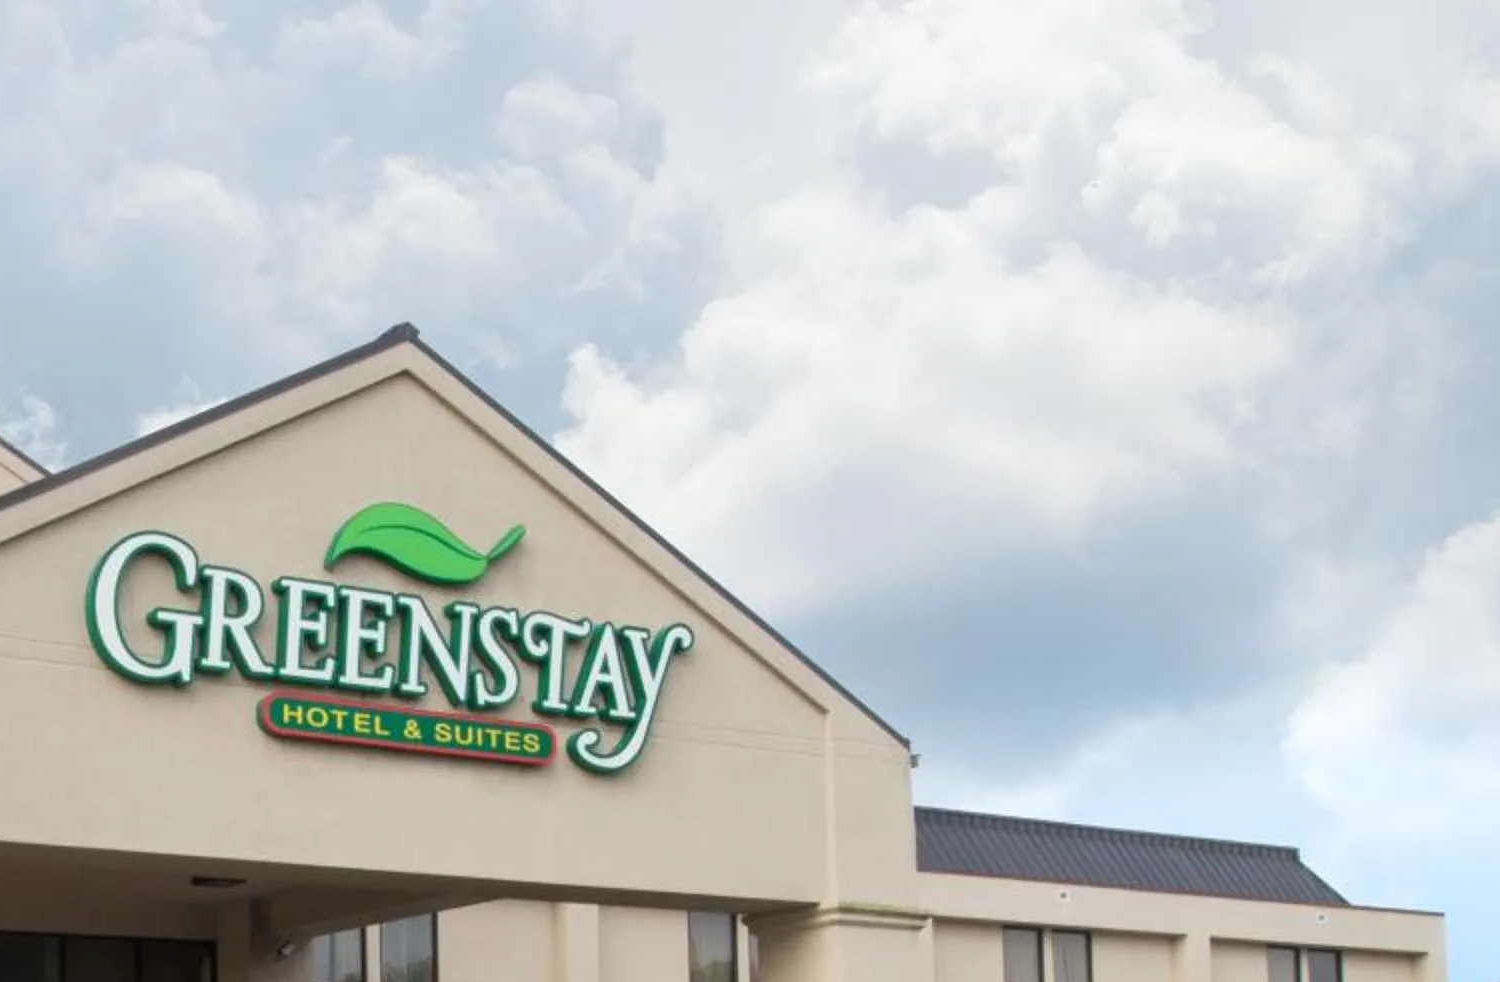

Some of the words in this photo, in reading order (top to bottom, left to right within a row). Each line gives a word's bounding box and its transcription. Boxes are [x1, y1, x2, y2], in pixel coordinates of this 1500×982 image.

[86, 530, 694, 775] GREENSTAY
[282, 703, 391, 736] HOTEL
[403, 719, 422, 740] &
[434, 722, 541, 753] SUITES
